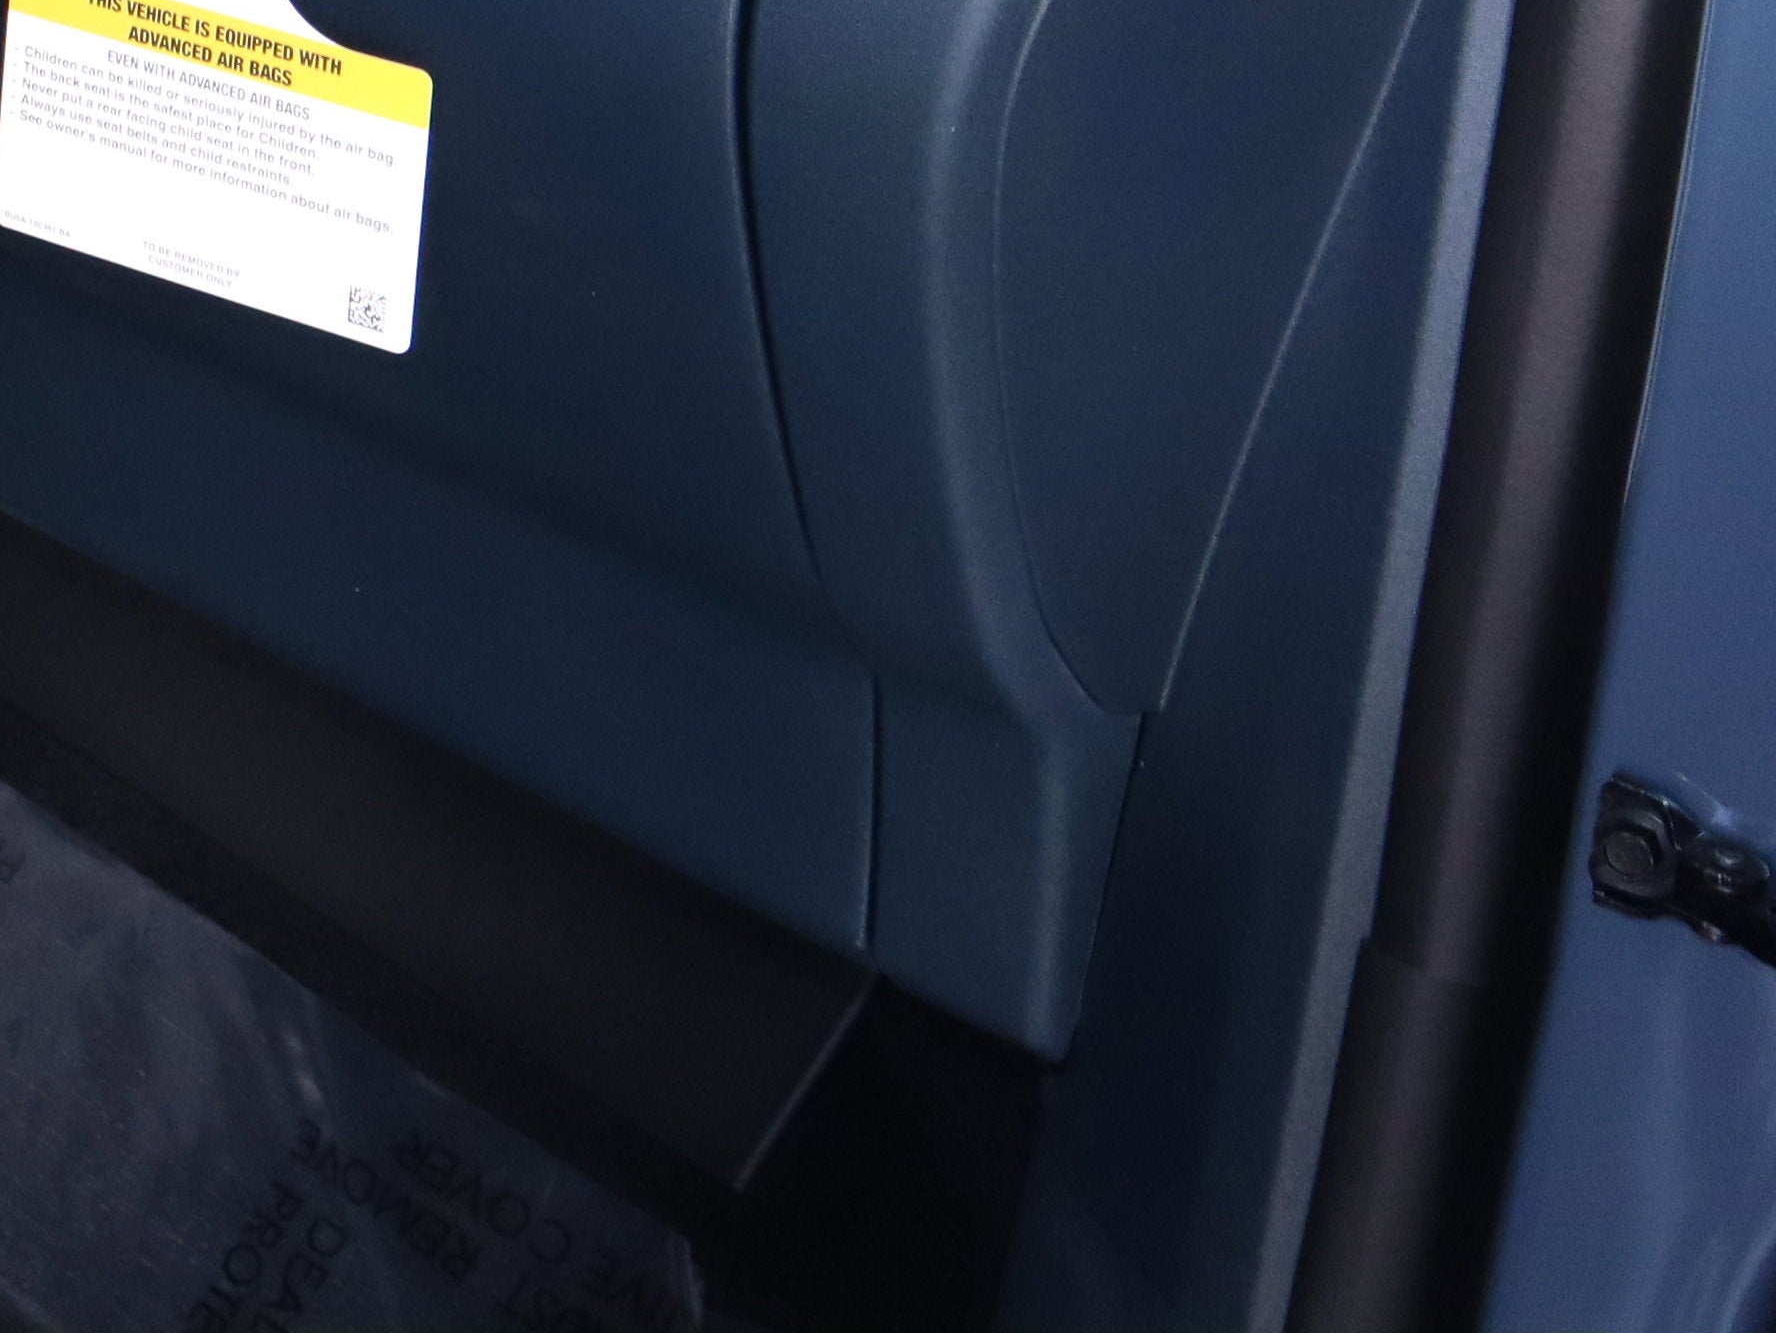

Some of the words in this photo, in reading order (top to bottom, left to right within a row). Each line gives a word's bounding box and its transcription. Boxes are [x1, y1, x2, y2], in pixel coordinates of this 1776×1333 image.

[107, 49, 139, 70] EVEN
[143, 59, 176, 82] WITH
[178, 70, 246, 102] ADVANCED
[249, 91, 272, 110] AIR
[275, 98, 310, 121] BAGS
[127, 0, 190, 30] VEHICLE
[195, 20, 209, 36] IS
[215, 26, 293, 60] EQUIPPED
[299, 50, 341, 75] WITH
[128, 26, 212, 61] ADVANCED
[217, 52, 244, 72] AIR
[249, 60, 291, 85] BAGS
[20, 93, 66, 117] Always
[69, 110, 93, 125] use
[96, 118, 123, 135] seat
[126, 124, 158, 145] belts
[161, 139, 187, 154] and
[190, 146, 223, 165] child
[226, 158, 293, 187] restraints.
[22, 76, 58, 98] Never
[61, 92, 83, 106] put
[85, 99, 94, 109] a
[97, 102, 123, 118] rear
[126, 108, 167, 134] facing
[169, 124, 203, 142] child
[206, 135, 234, 151] seat
[238, 143, 250, 157] in
[254, 147, 275, 164] the
[279, 154, 314, 176] front.
[23, 60, 46, 78] The
[49, 69, 80, 88] back
[83, 82, 111, 98] seat
[114, 88, 125, 102] is
[129, 93, 150, 109] the
[153, 102, 193, 123] safest
[196, 115, 232, 134] place
[236, 124, 255, 140] for
[258, 132, 316, 159] Children.
[24, 45, 78, 71] Children
[81, 64, 104, 79] can
[107, 69, 124, 85] be
[127, 75, 162, 97] killed
[165, 90, 180, 101] or
[183, 95, 245, 123] seriously
[248, 111, 296, 136] injured
[299, 126, 316, 144] by
[320, 133, 342, 150] the
[345, 143, 364, 156] air
[367, 146, 394, 168] bag.
[19, 109, 43, 127] See
[46, 119, 96, 143] owner's
[99, 136, 147, 158] manual
[150, 149, 168, 165] for
[172, 158, 206, 176] more
[209, 168, 287, 201] information
[290, 194, 330, 215] about
[333, 208, 352, 221] air
[355, 211, 393, 234] bags.
